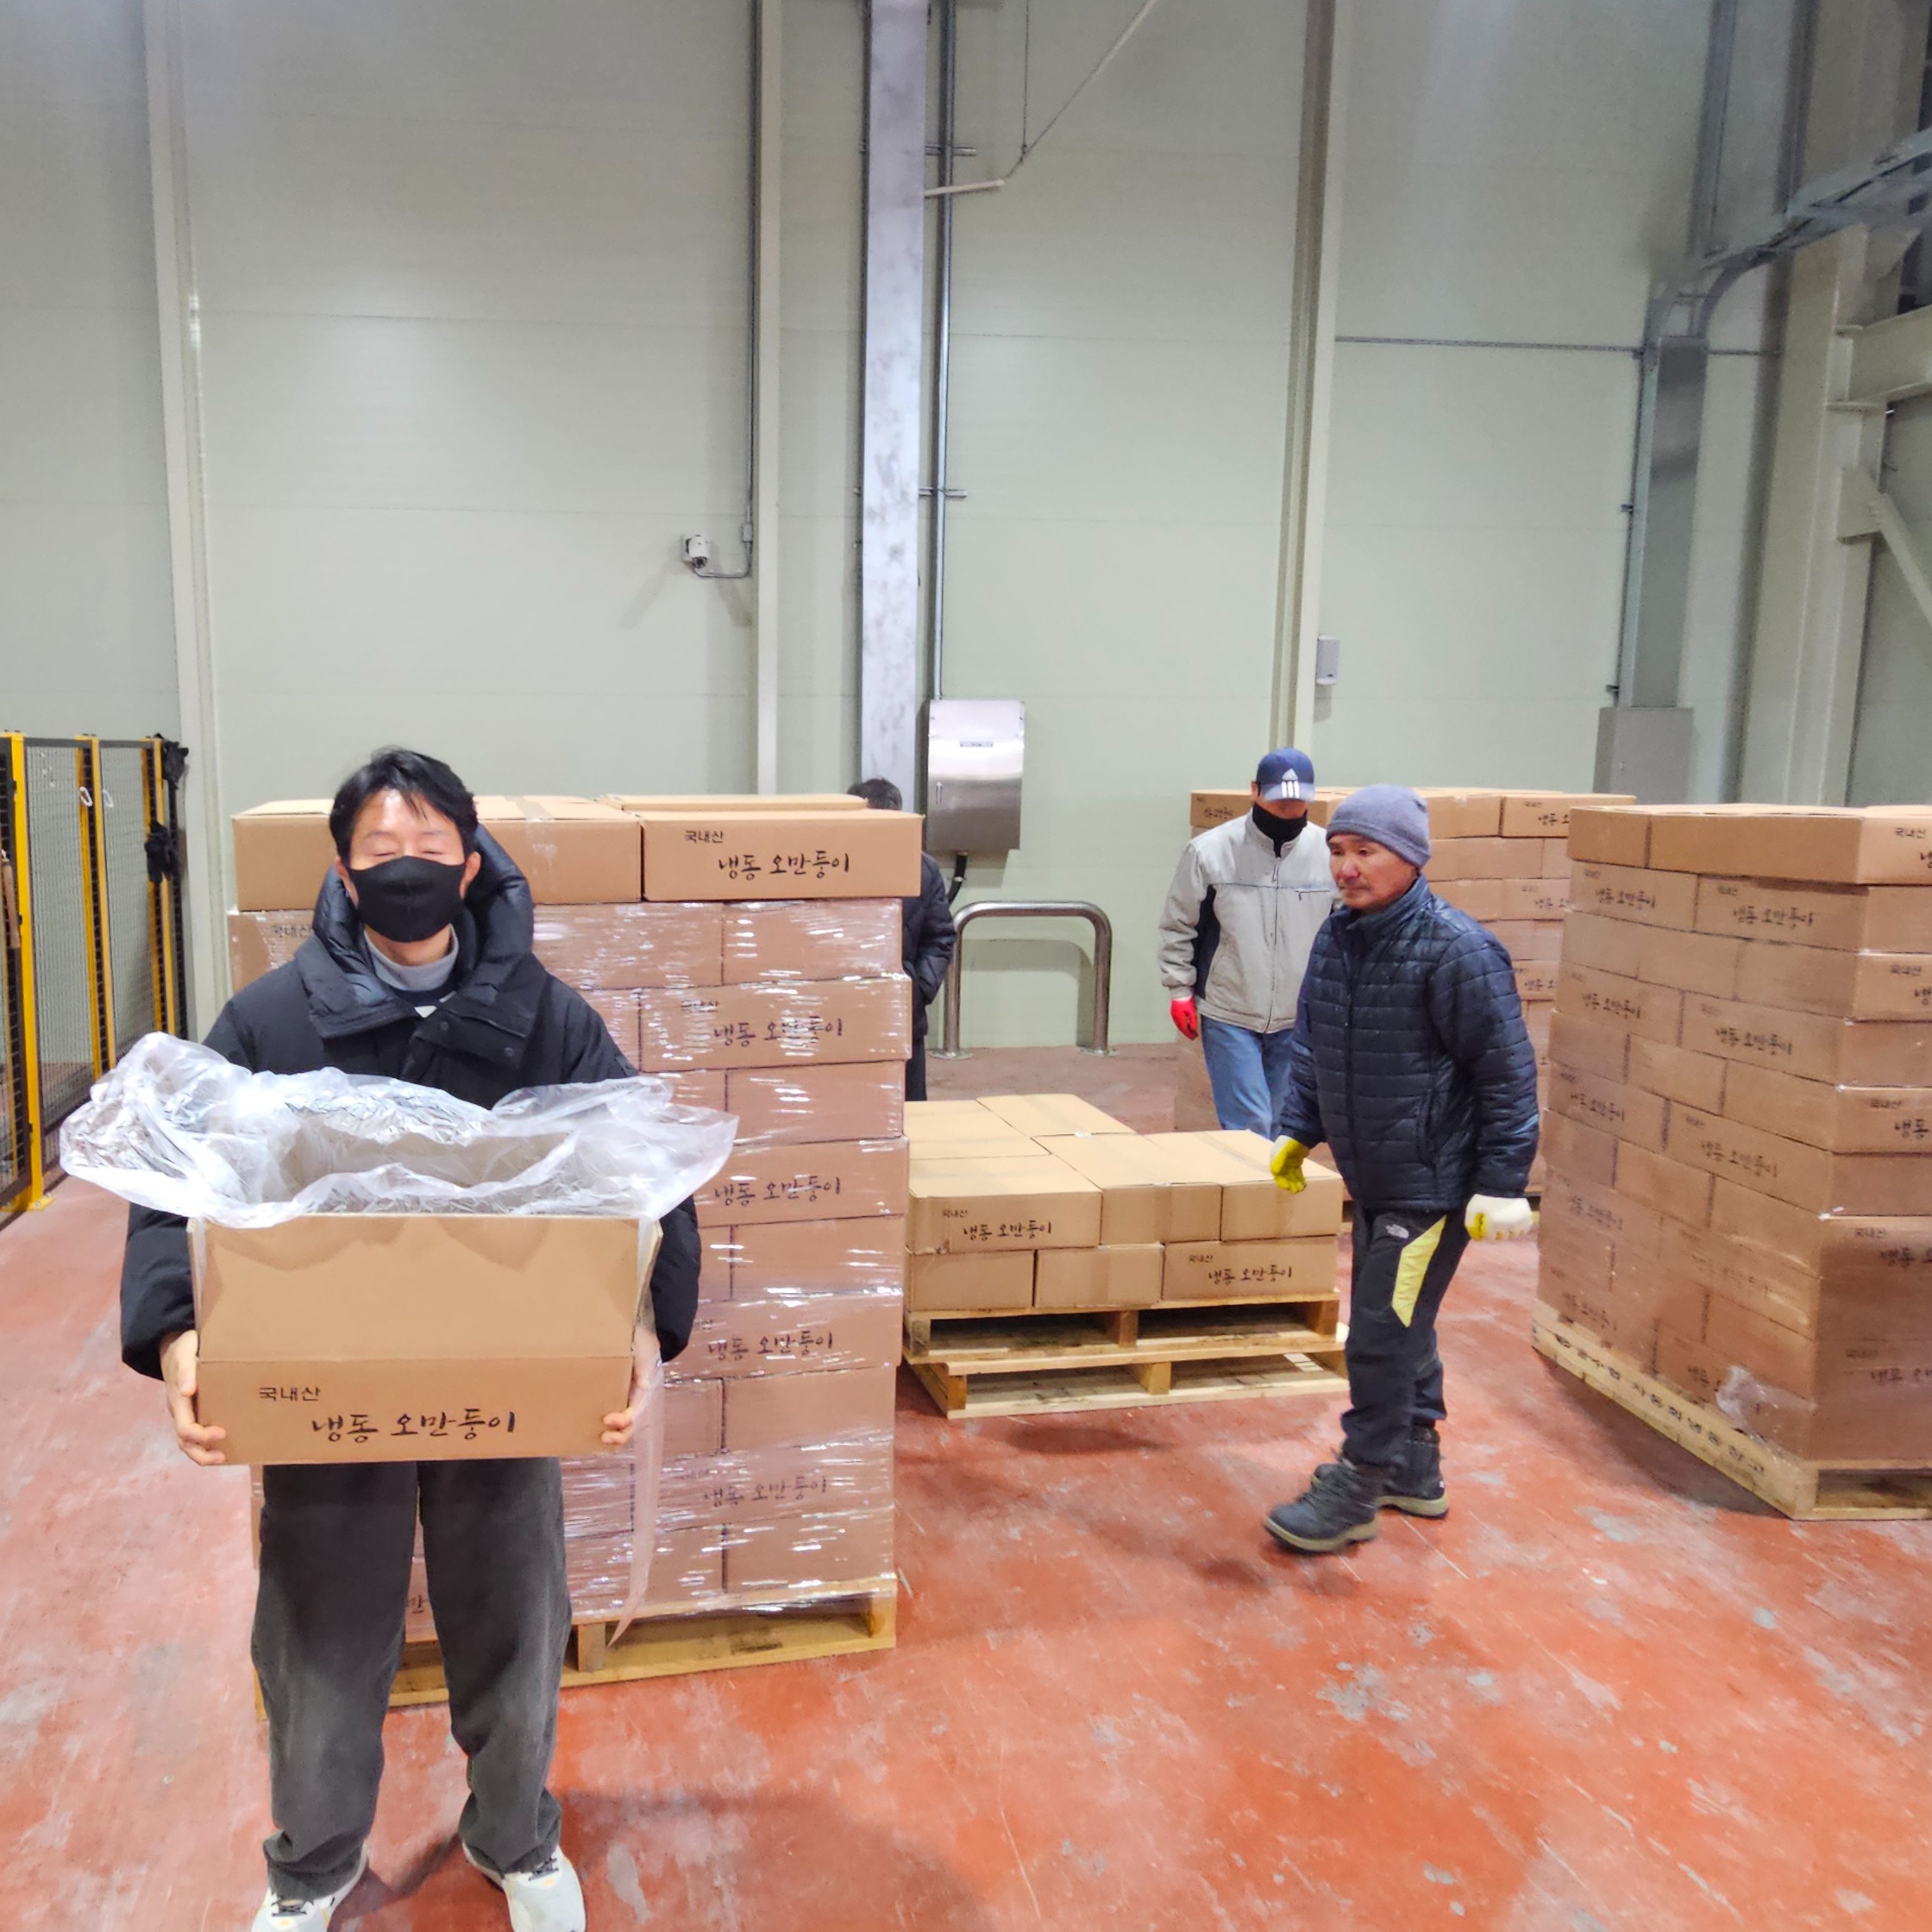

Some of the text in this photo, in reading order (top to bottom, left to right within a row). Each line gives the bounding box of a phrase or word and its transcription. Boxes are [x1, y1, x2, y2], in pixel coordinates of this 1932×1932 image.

[685, 830, 724, 844] 국내산
[718, 850, 850, 881] 냉동 오만둥이
[714, 1023, 756, 1046] 냉동
[715, 1176, 841, 1207] 냉동 오만둥이
[963, 1220, 1051, 1241] 냉동 오만둥이
[1208, 1264, 1292, 1285] 냉동 오만둥이
[708, 1330, 832, 1361] 냉동 오만둥이
[259, 1386, 321, 1402] 국내산
[311, 1408, 515, 1443] 냉동 오만둥이
